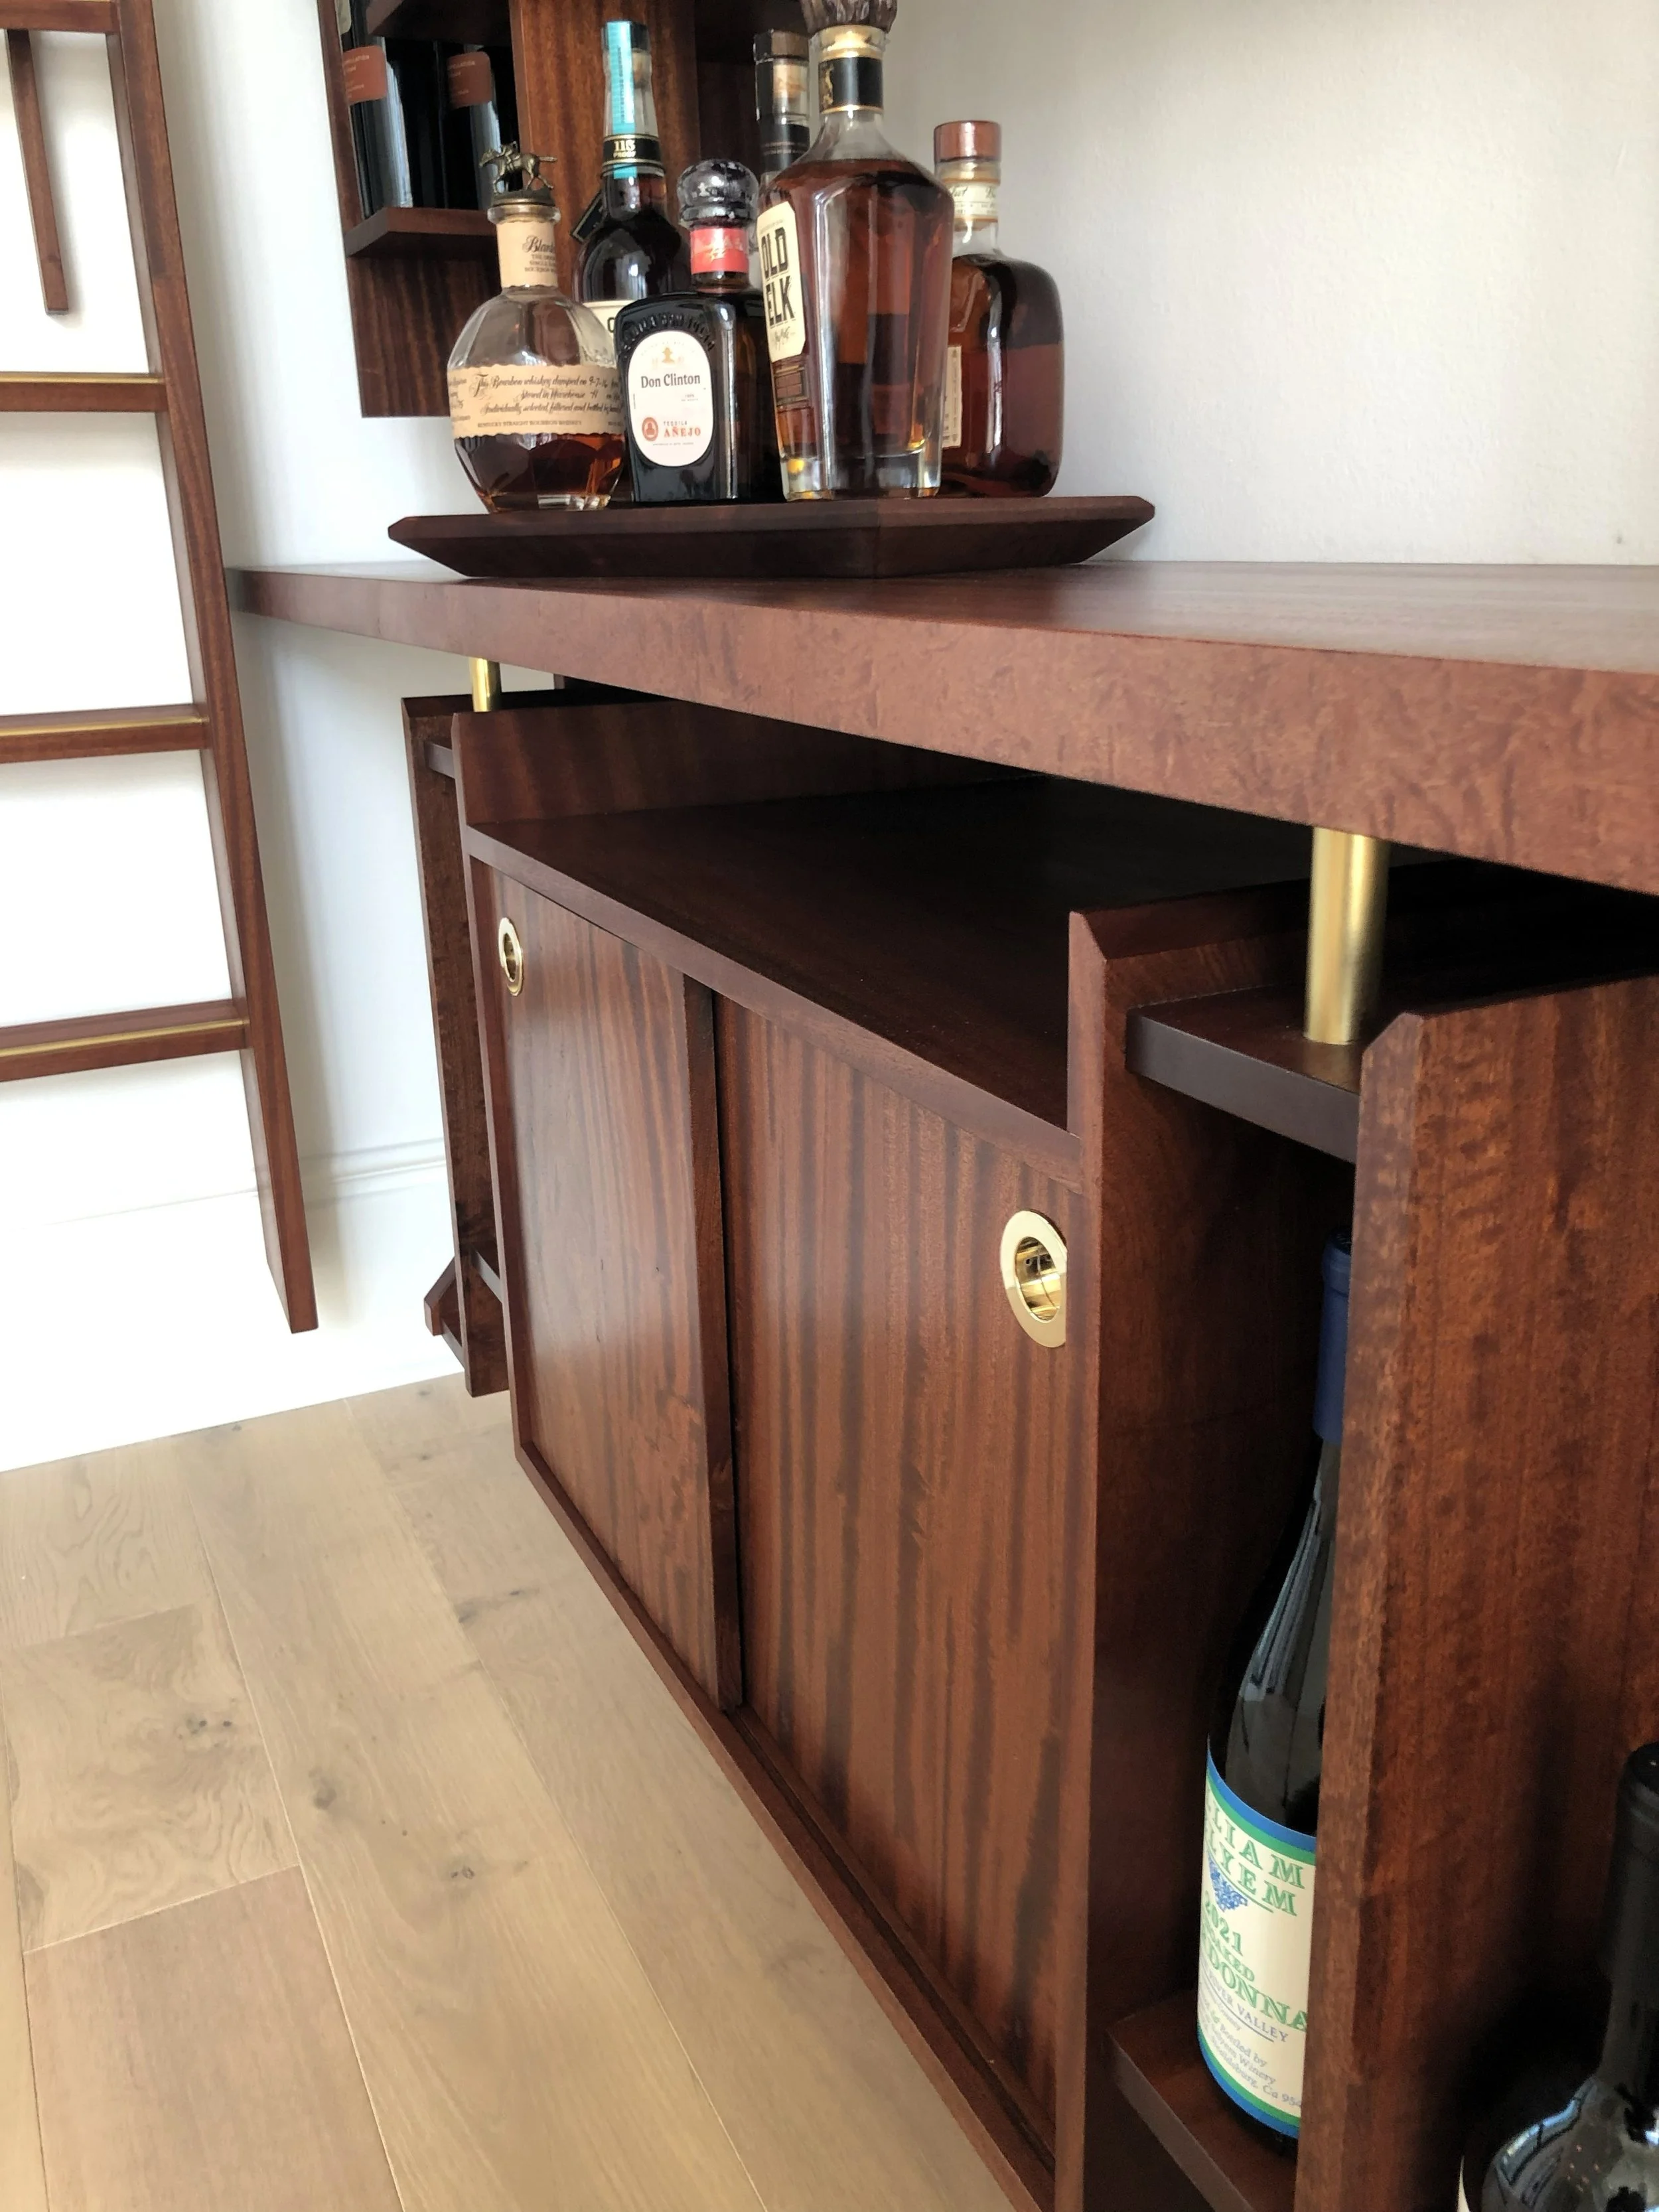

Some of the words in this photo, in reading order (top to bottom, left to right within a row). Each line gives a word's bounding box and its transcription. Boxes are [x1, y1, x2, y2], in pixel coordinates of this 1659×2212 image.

[614, 139, 636, 151] 115
[761, 226, 788, 279] OLD
[766, 275, 796, 326] ELK
[469, 373, 489, 398] This
[491, 375, 522, 389] Bourbon
[641, 376, 661, 388] Don
[664, 373, 701, 387] Clinton
[664, 427, 701, 438] AÑEJO
[1204, 1889, 1244, 1956] 2021
[1237, 2003, 1289, 2043] VALLEY
[1238, 2053, 1277, 2085] Winery
[1253, 2051, 1267, 2068] by
[1262, 2084, 1279, 2099] Ca
